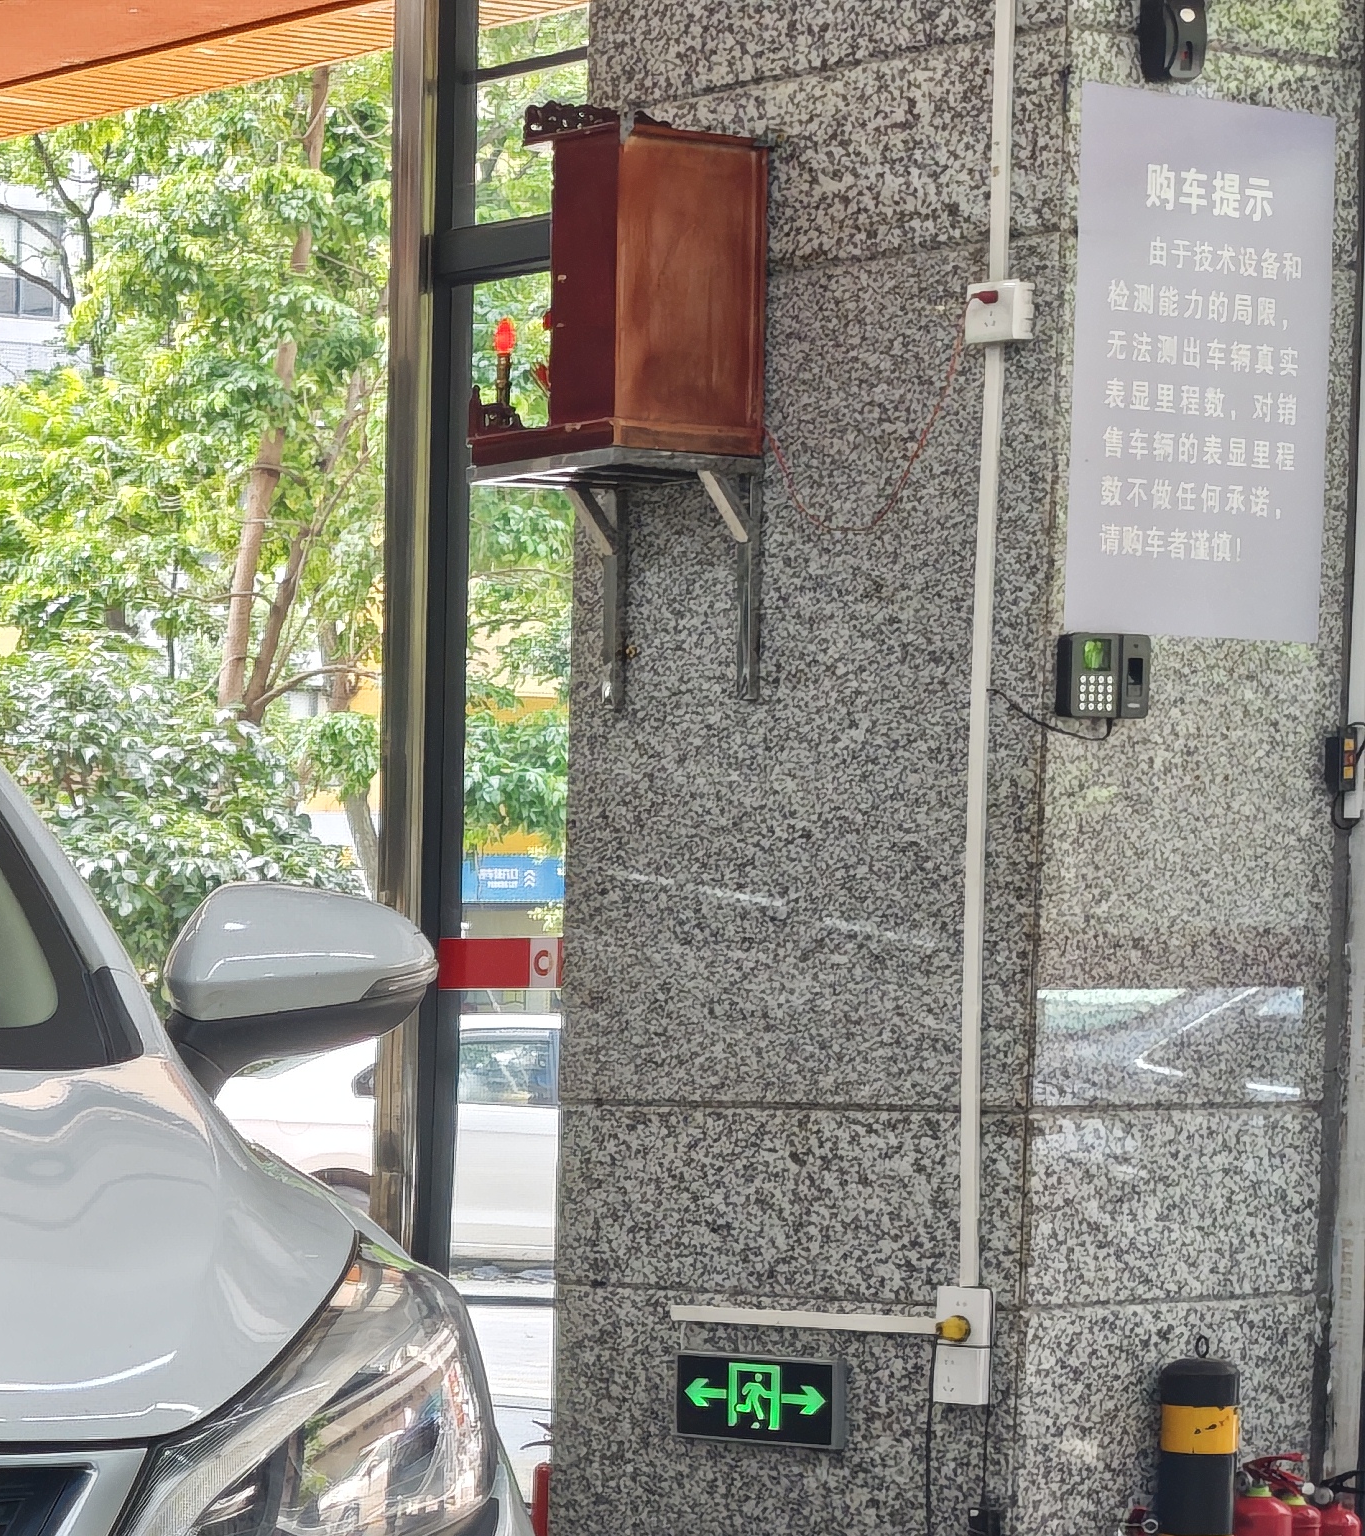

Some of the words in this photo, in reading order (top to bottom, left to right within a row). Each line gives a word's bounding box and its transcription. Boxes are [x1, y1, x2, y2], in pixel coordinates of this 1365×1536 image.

[1145, 164, 1274, 222] 购车提示
[1148, 236, 1302, 281] 由于技术设备和
[1106, 279, 1289, 331] 检测能力的局限，
[1106, 330, 1299, 377] 无法测出车辆真实
[1103, 377, 1297, 425] 表显里程数，对销
[1102, 425, 1295, 471] 售车辆的表显里程
[1100, 475, 1282, 520] 数不做任何承诺，
[1099, 523, 1241, 562] 请购车者谨慎！
